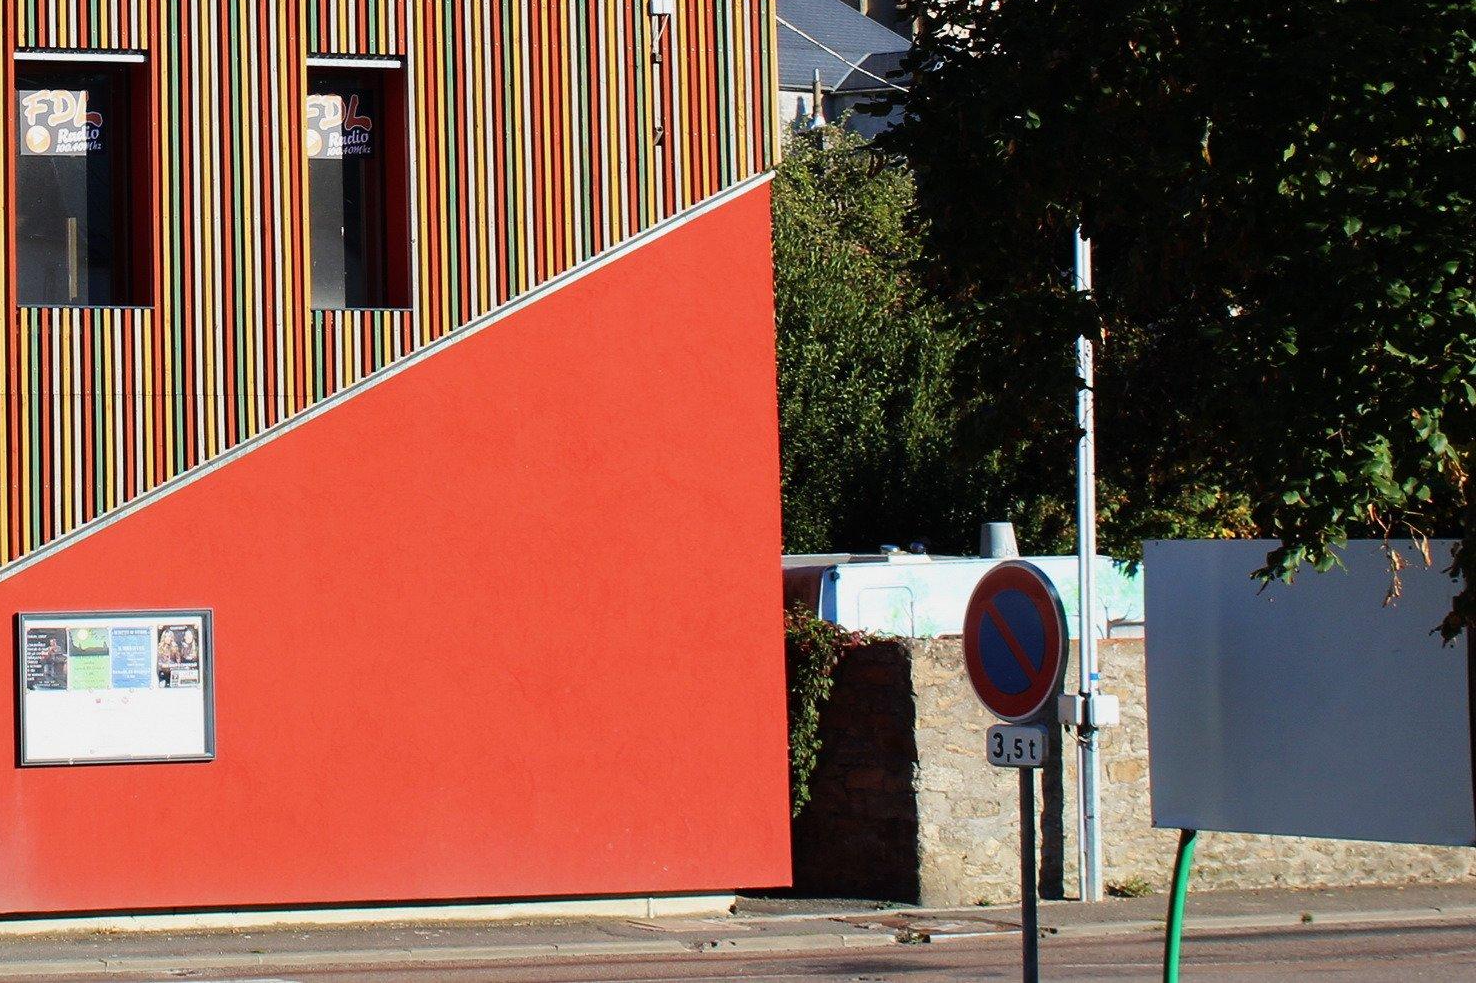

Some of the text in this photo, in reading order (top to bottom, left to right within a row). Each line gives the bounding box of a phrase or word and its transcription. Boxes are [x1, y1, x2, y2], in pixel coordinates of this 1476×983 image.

[22, 89, 103, 127] FDL
[58, 126, 99, 143] Radio
[329, 130, 368, 147] Radio
